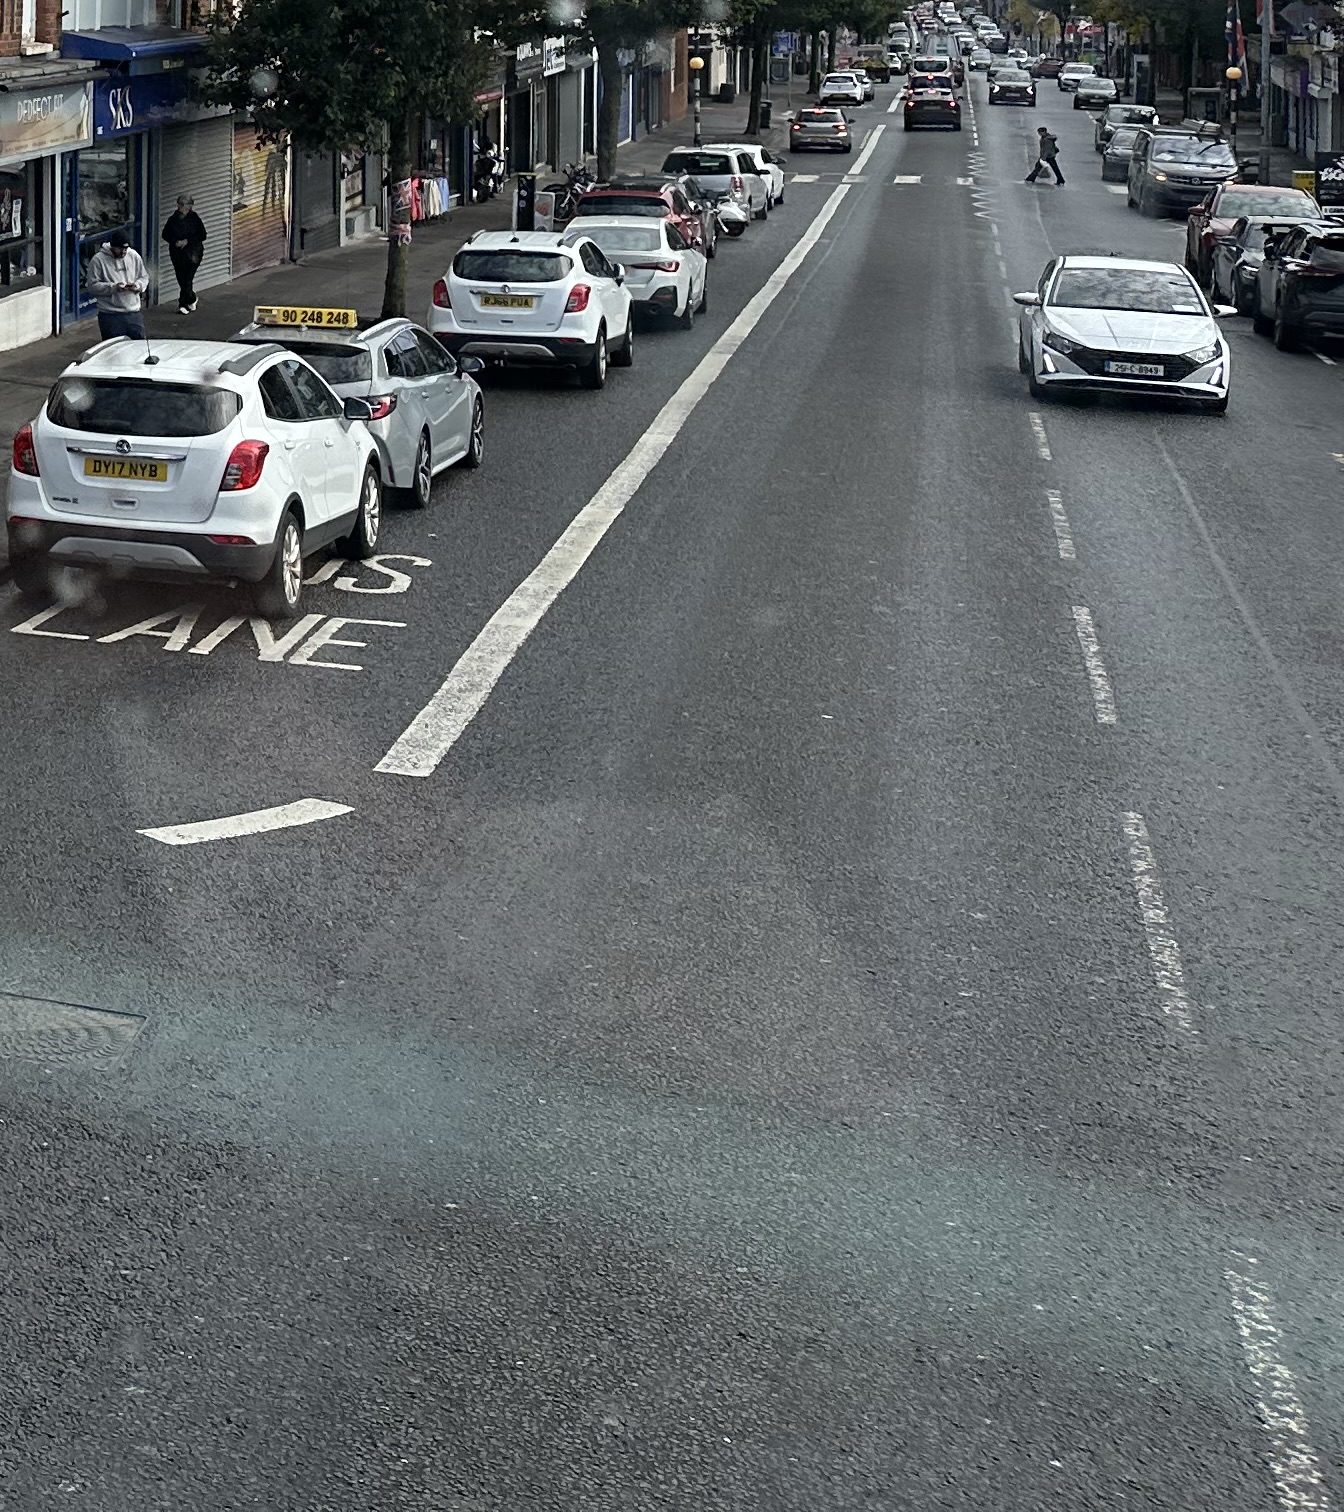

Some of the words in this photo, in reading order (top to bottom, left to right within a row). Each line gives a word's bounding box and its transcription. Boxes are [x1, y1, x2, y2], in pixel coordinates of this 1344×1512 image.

[282, 309, 297, 322] 90
[300, 311, 323, 324] 248
[327, 311, 349, 324] 248
[93, 459, 125, 476] DY17
[129, 462, 158, 478] NYB
[10, 602, 407, 671] LANE
